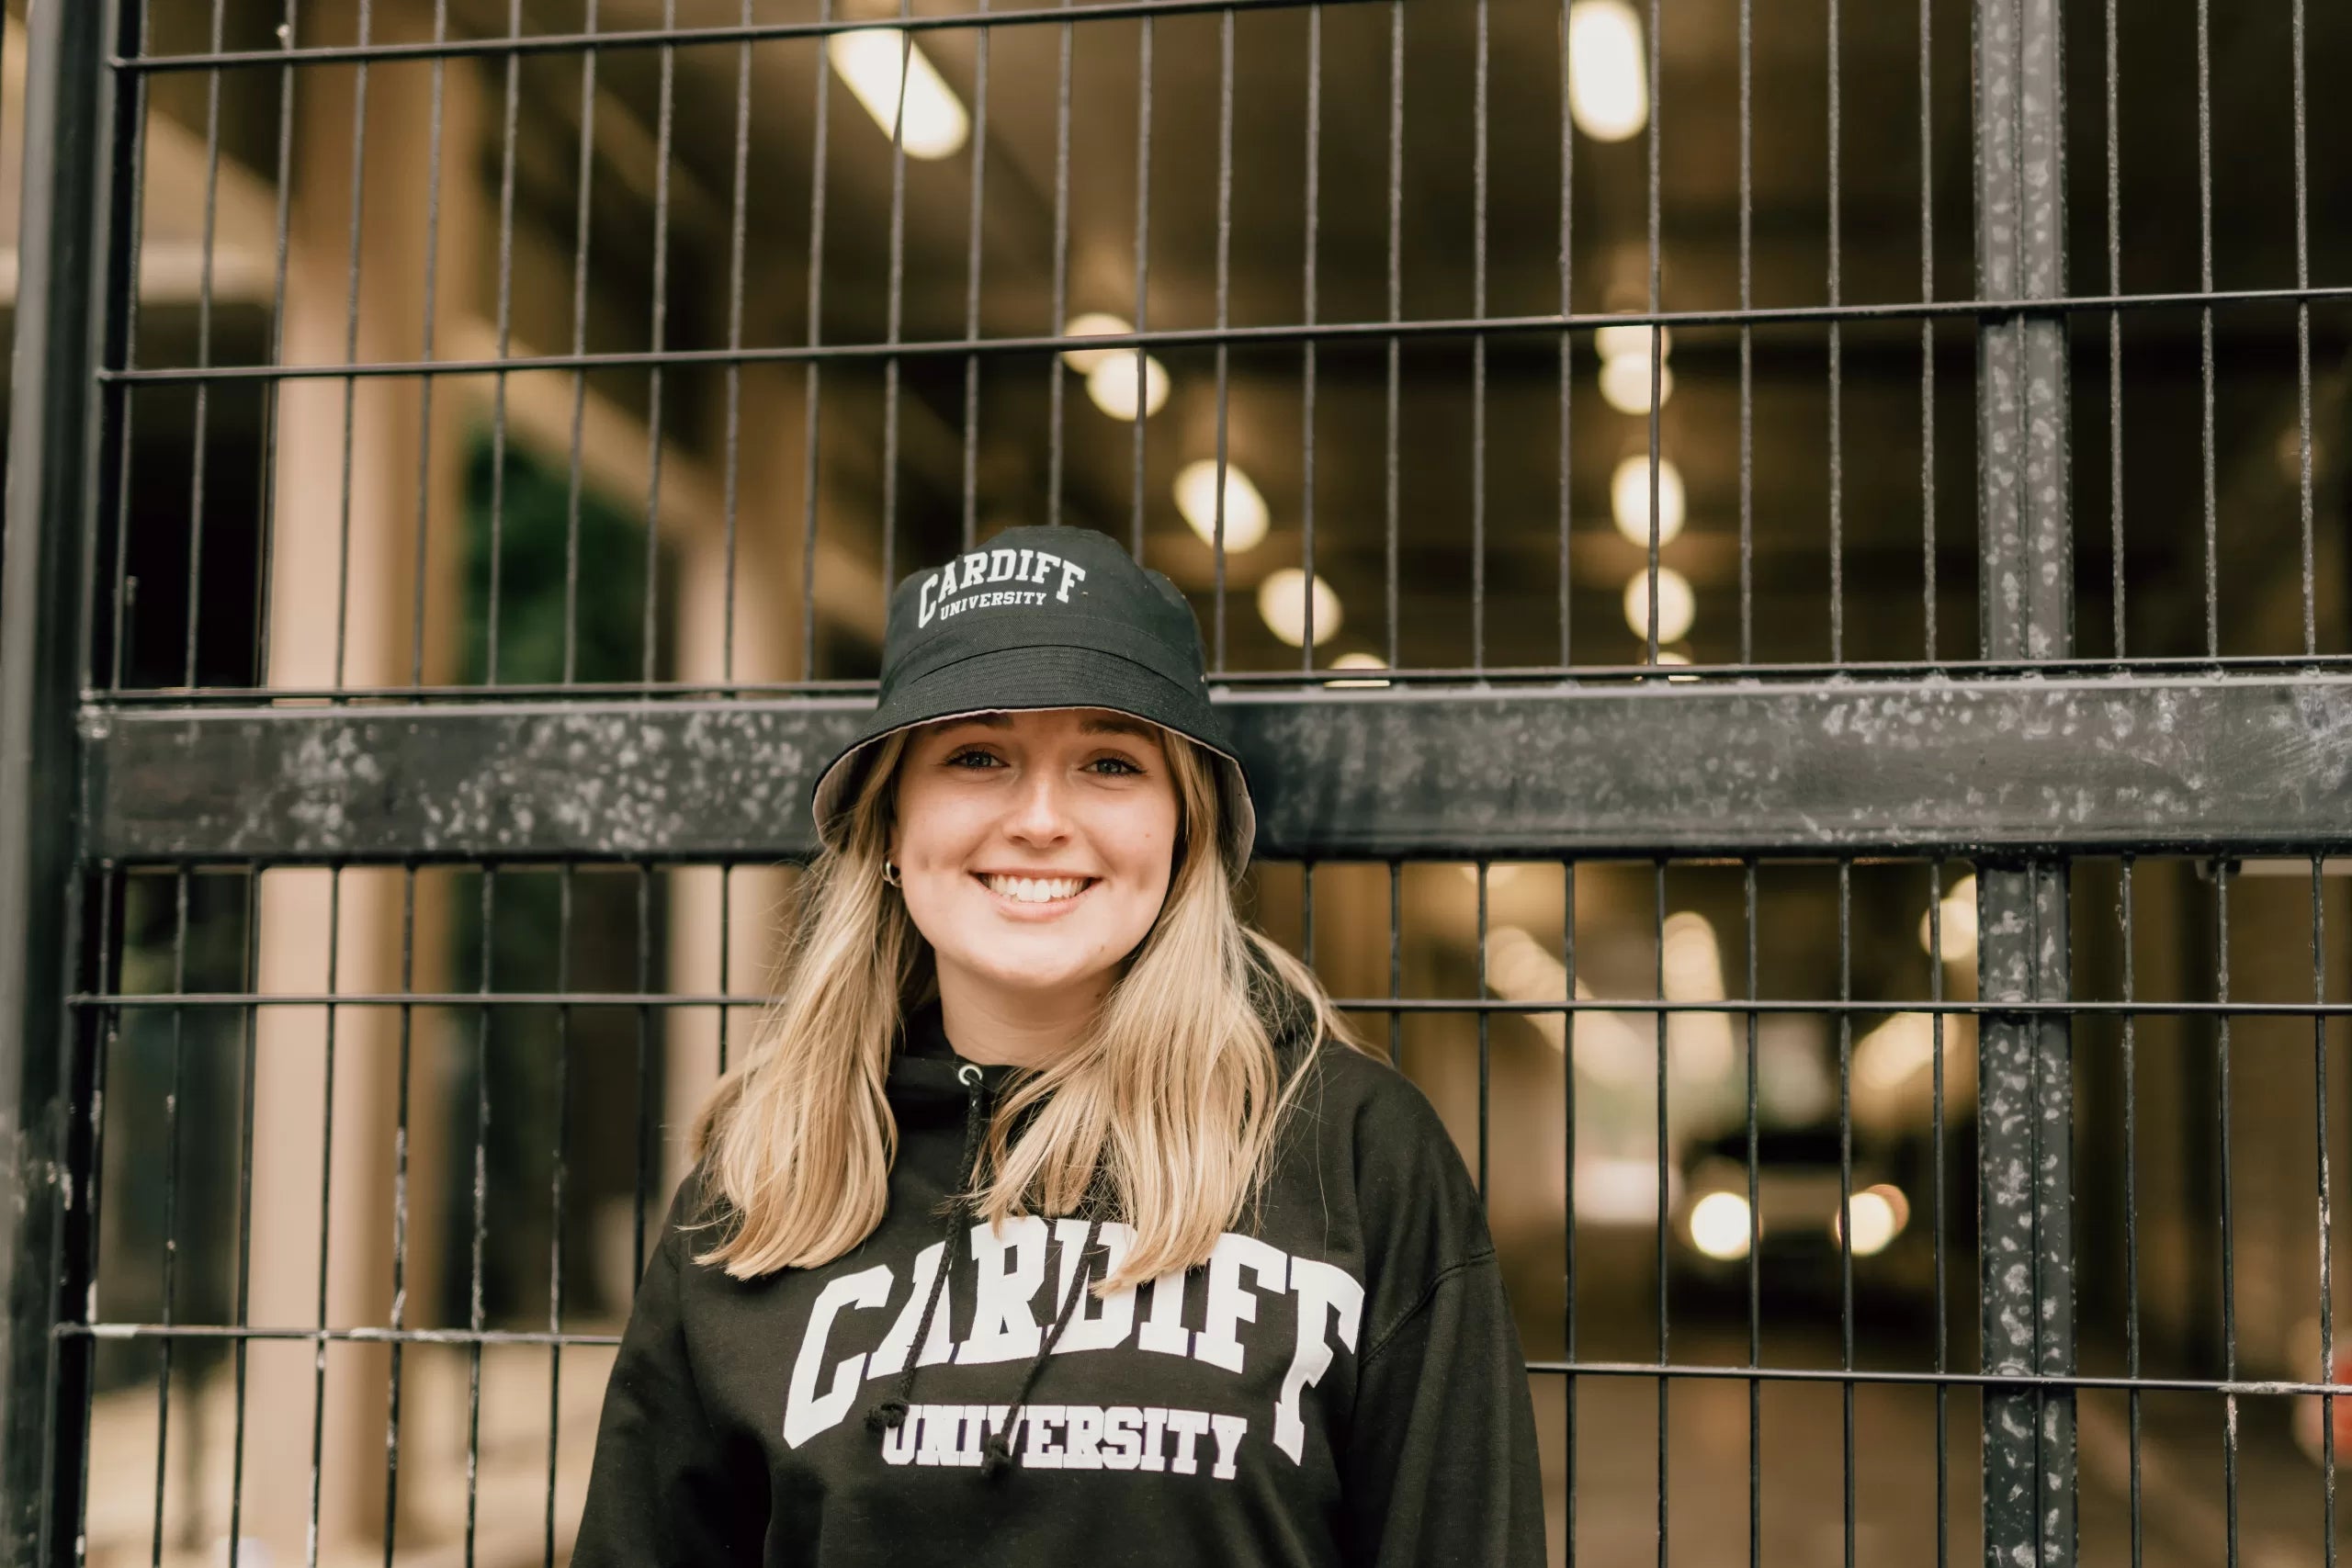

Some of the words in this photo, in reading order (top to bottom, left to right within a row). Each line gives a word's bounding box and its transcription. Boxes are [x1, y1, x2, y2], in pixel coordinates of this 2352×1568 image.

[919, 548, 1086, 628] CARDIFF
[940, 591, 1046, 621] UNIVERSITY
[784, 1215, 1365, 1466] CARDIFF
